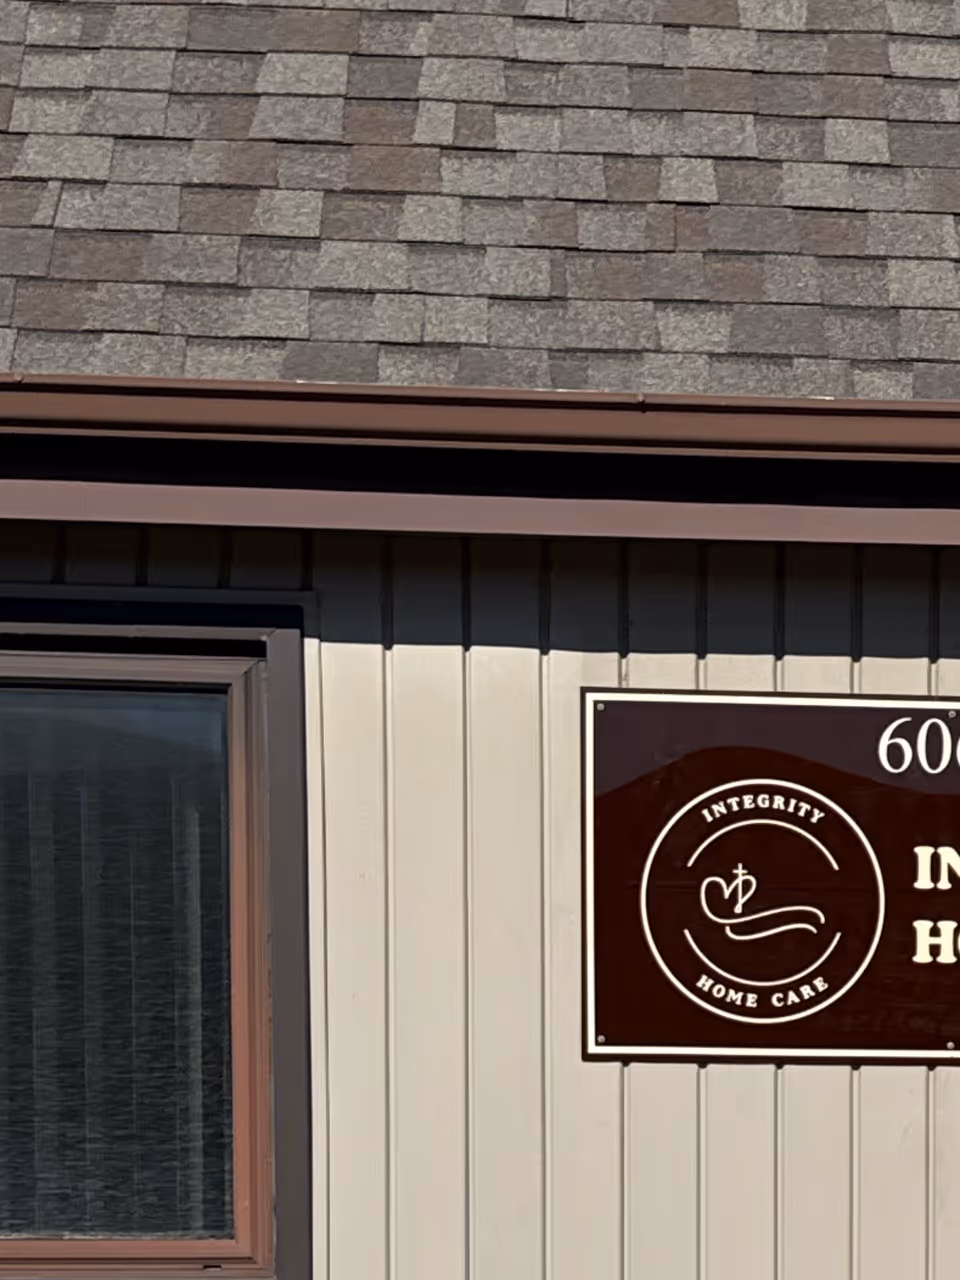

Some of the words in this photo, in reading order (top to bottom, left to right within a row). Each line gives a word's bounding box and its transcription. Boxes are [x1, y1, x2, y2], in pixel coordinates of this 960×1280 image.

[701, 794, 826, 824] INTEGRITY
[695, 973, 758, 1008] HOME
[771, 976, 829, 1008] CARE
